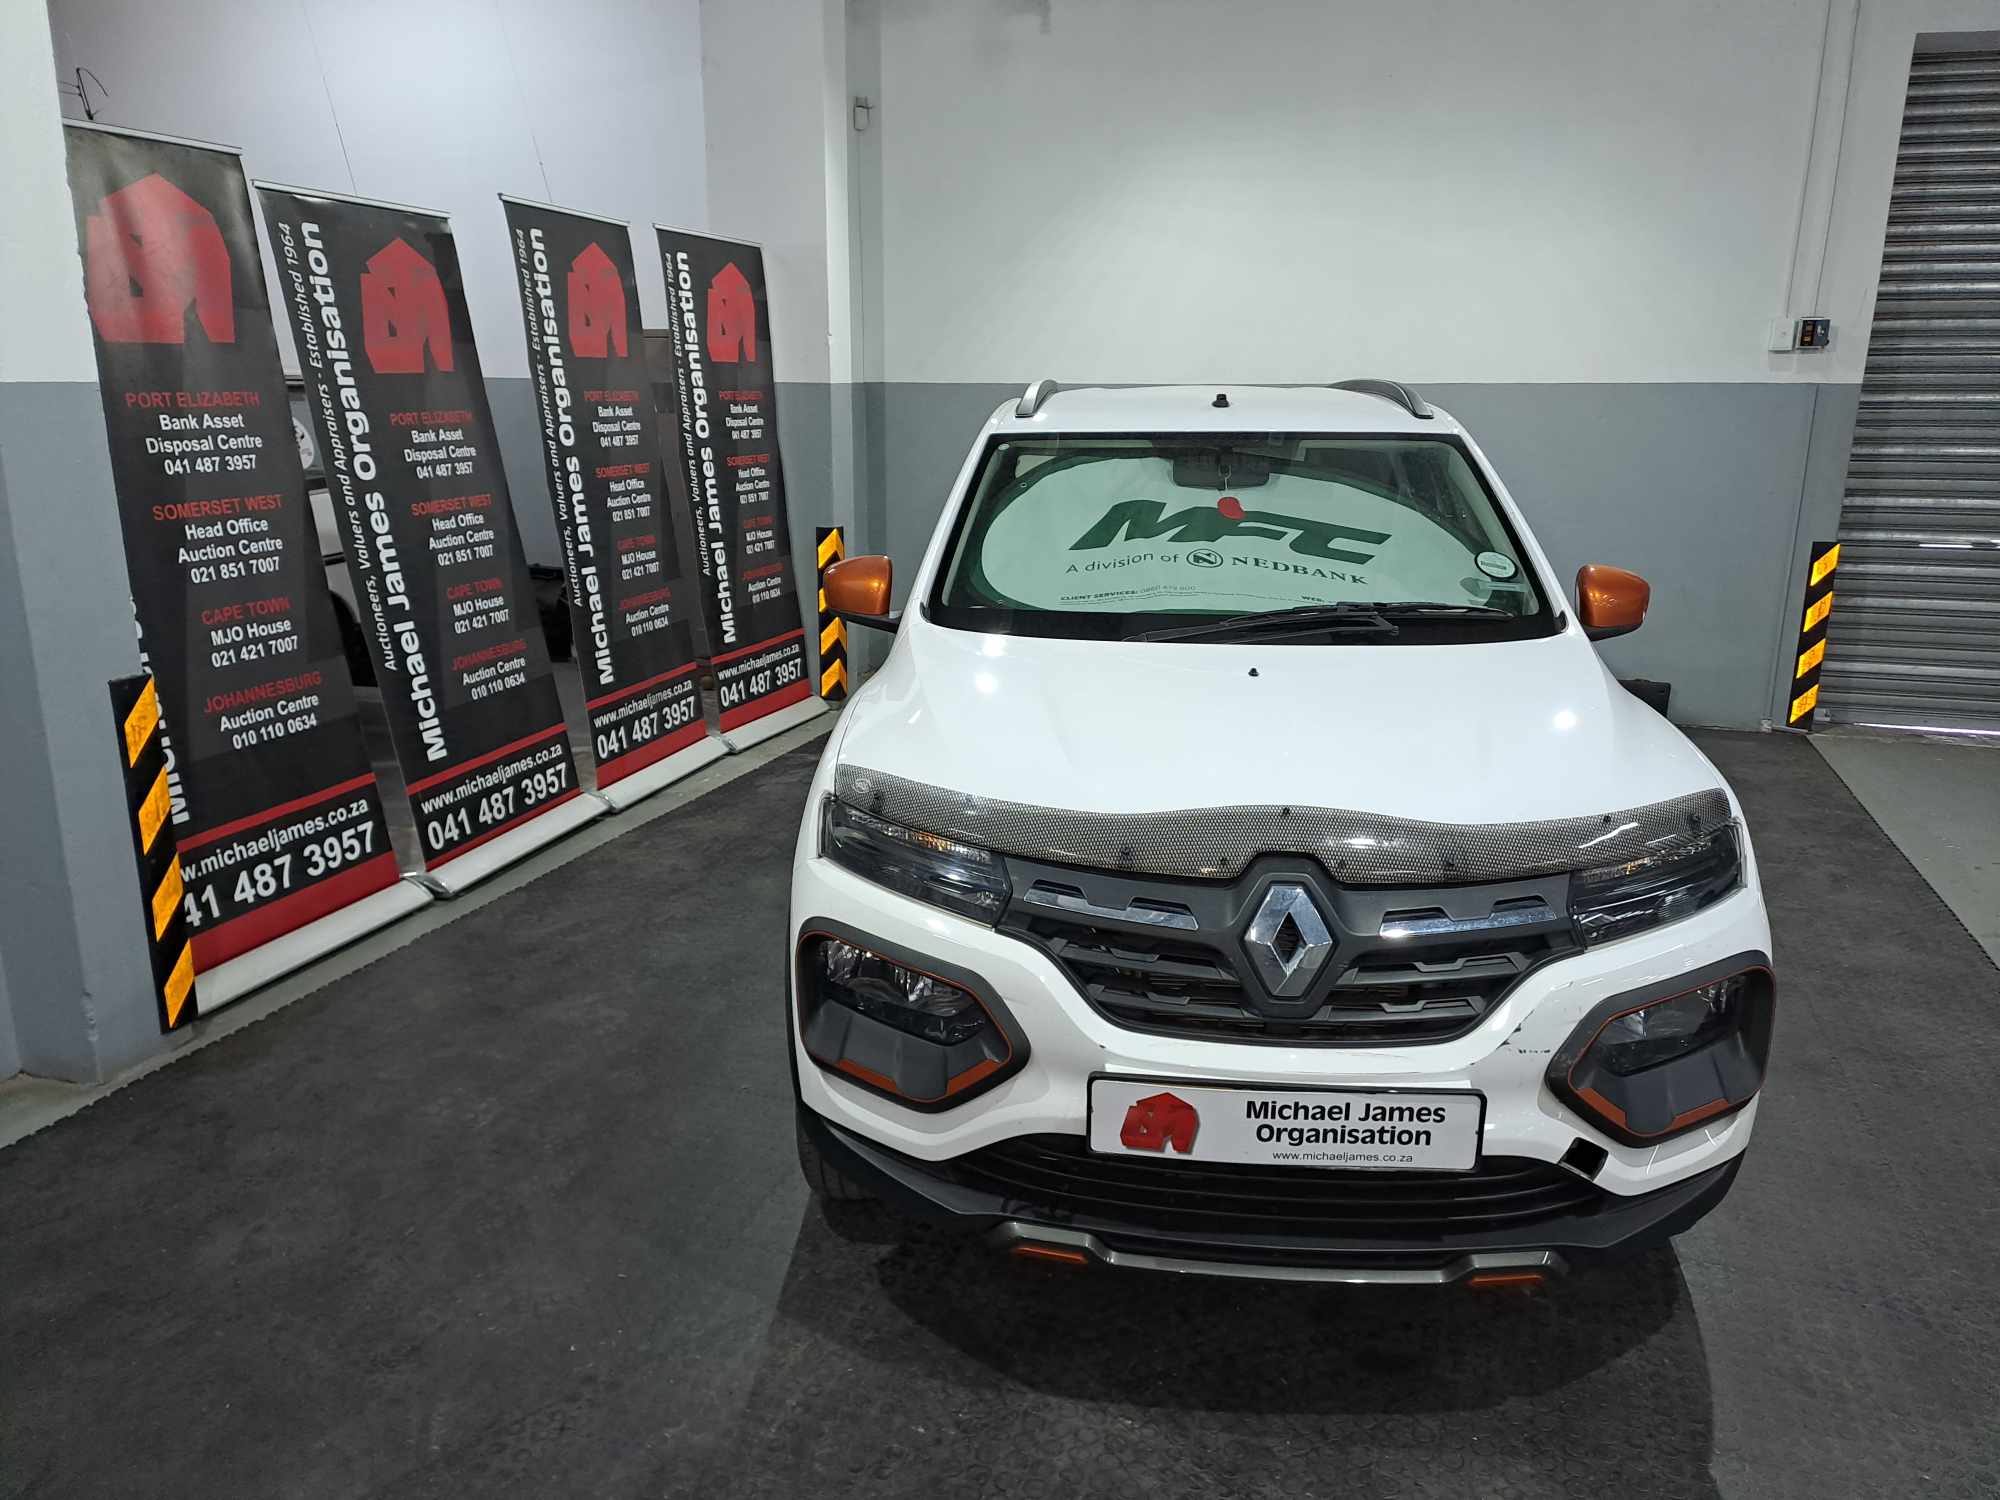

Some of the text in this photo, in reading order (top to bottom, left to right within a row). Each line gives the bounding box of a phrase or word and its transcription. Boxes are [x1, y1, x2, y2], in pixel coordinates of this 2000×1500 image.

[277, 221, 299, 267] 1964
[515, 228, 528, 266] 1964
[293, 272, 323, 369] Established
[523, 268, 541, 351] Established
[125, 391, 261, 409] PORT ELIZABETH
[536, 363, 556, 438] Appraisers
[159, 413, 245, 431] Bank Asset
[318, 383, 347, 471] Appraisers
[411, 428, 463, 444] Bank Asset
[145, 434, 263, 456] Disposal Centre
[404, 444, 477, 463] Disposal Centre
[530, 228, 615, 685] Michael James Organisation
[549, 440, 560, 468] and
[676, 251, 737, 644] Michael James Organisation
[683, 432, 695, 456] and
[164, 454, 257, 476] 041 487 3957
[417, 461, 473, 480] 041 487 3957
[688, 459, 702, 502] Valuers
[301, 221, 448, 763] Michael James Organisation
[340, 474, 356, 507] and
[411, 496, 466, 517] SOMERSET
[552, 471, 569, 521] Valuers
[152, 494, 284, 521] SOMERSET WEST
[432, 513, 484, 531] Head Office
[185, 518, 269, 541] Head Office
[349, 510, 370, 570] Valuers
[429, 528, 494, 550] Auction Centre
[178, 537, 283, 564] Auction Centre
[438, 551, 454, 566] 021
[456, 548, 474, 563] 851
[190, 556, 280, 584] 021 851 7007
[1065, 564, 1079, 574] A
[1085, 552, 1153, 572] division
[1160, 553, 1180, 563] of
[1232, 556, 1369, 585] NEDBANK
[201, 597, 290, 625] CAPE TOWN
[453, 594, 504, 616] MJO House
[455, 609, 510, 634] 021 421 7007
[210, 619, 292, 646] MJO House
[366, 574, 397, 672] Auctioneers,
[211, 635, 299, 668] 021 421 7007
[718, 643, 800, 680] www.michaeljames.co.za
[462, 656, 526, 685] Auction Centre
[471, 672, 526, 700] 010 110 0634
[720, 658, 801, 708] 041 487 3957
[204, 671, 322, 713] JOHANNESBURG
[594, 679, 693, 729] www.michaeljames.co.za
[220, 694, 320, 732] Auction Centre
[597, 696, 695, 760] 041 487 3957
[232, 713, 318, 750] 010 110 0634
[421, 743, 563, 815] www.michaeljames.co.za
[427, 762, 568, 850] 041 487 3957
[180, 798, 369, 883] w.michaeljames.co.za
[183, 821, 374, 928] 41 487 3957
[1246, 1100, 1446, 1123] Michael James
[1256, 1123, 1432, 1147] Organisation
[1272, 1151, 1414, 1164] www.michaeljames.co.za
